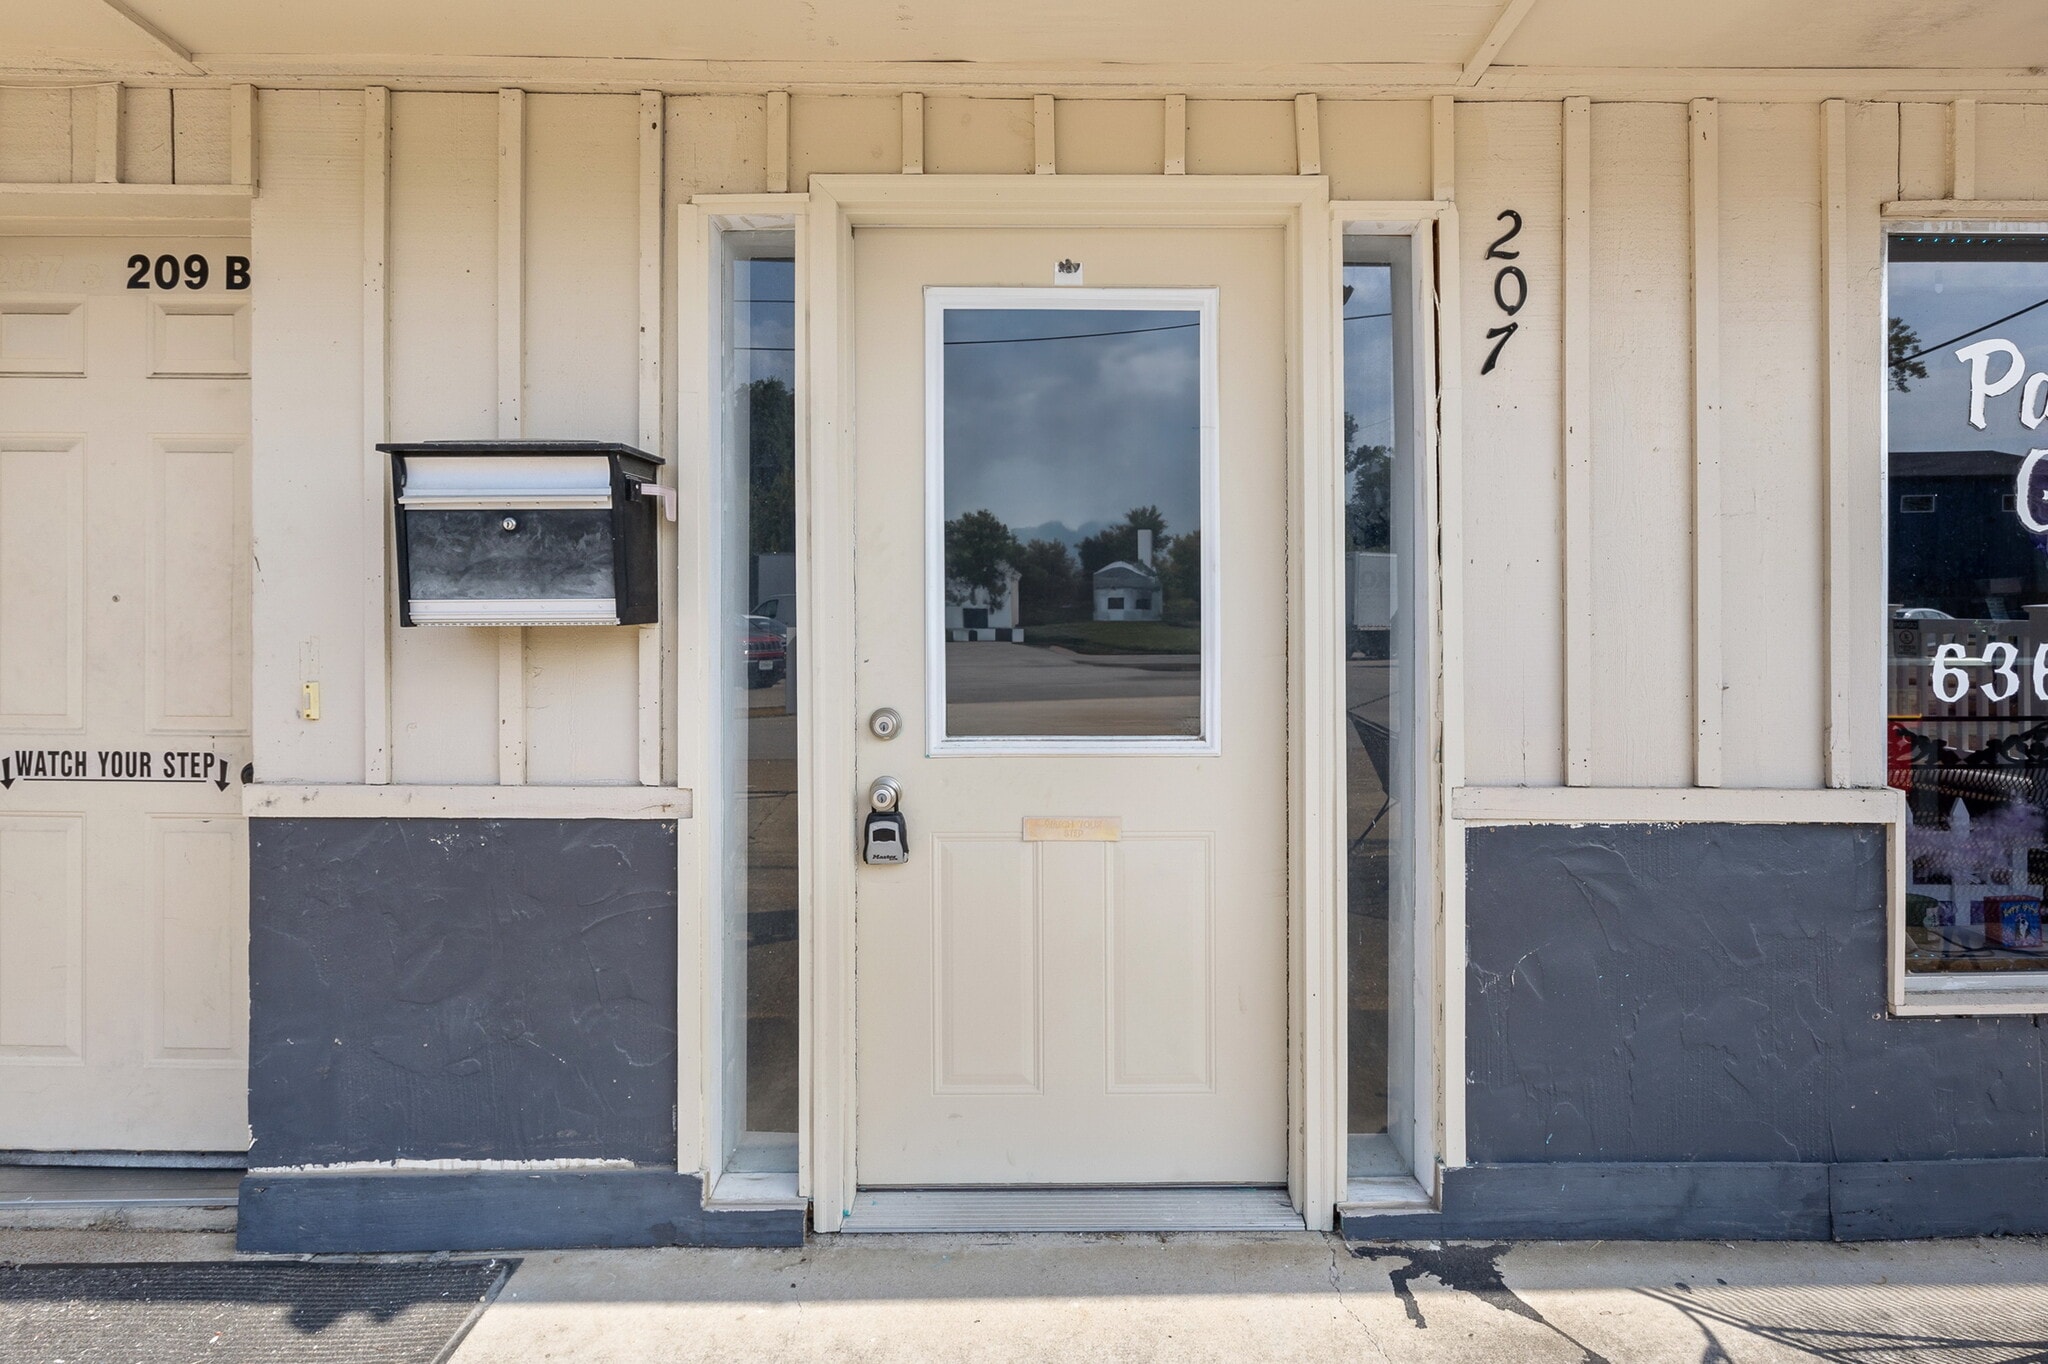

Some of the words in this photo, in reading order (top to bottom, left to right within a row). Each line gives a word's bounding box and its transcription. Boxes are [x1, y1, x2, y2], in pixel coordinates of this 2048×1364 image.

[126, 254, 209, 290] 209
[225, 256, 251, 290] B
[1481, 209, 1527, 375] 207
[15, 751, 87, 777] WATCH
[98, 752, 151, 778] YOUR
[163, 753, 215, 778] STEP
